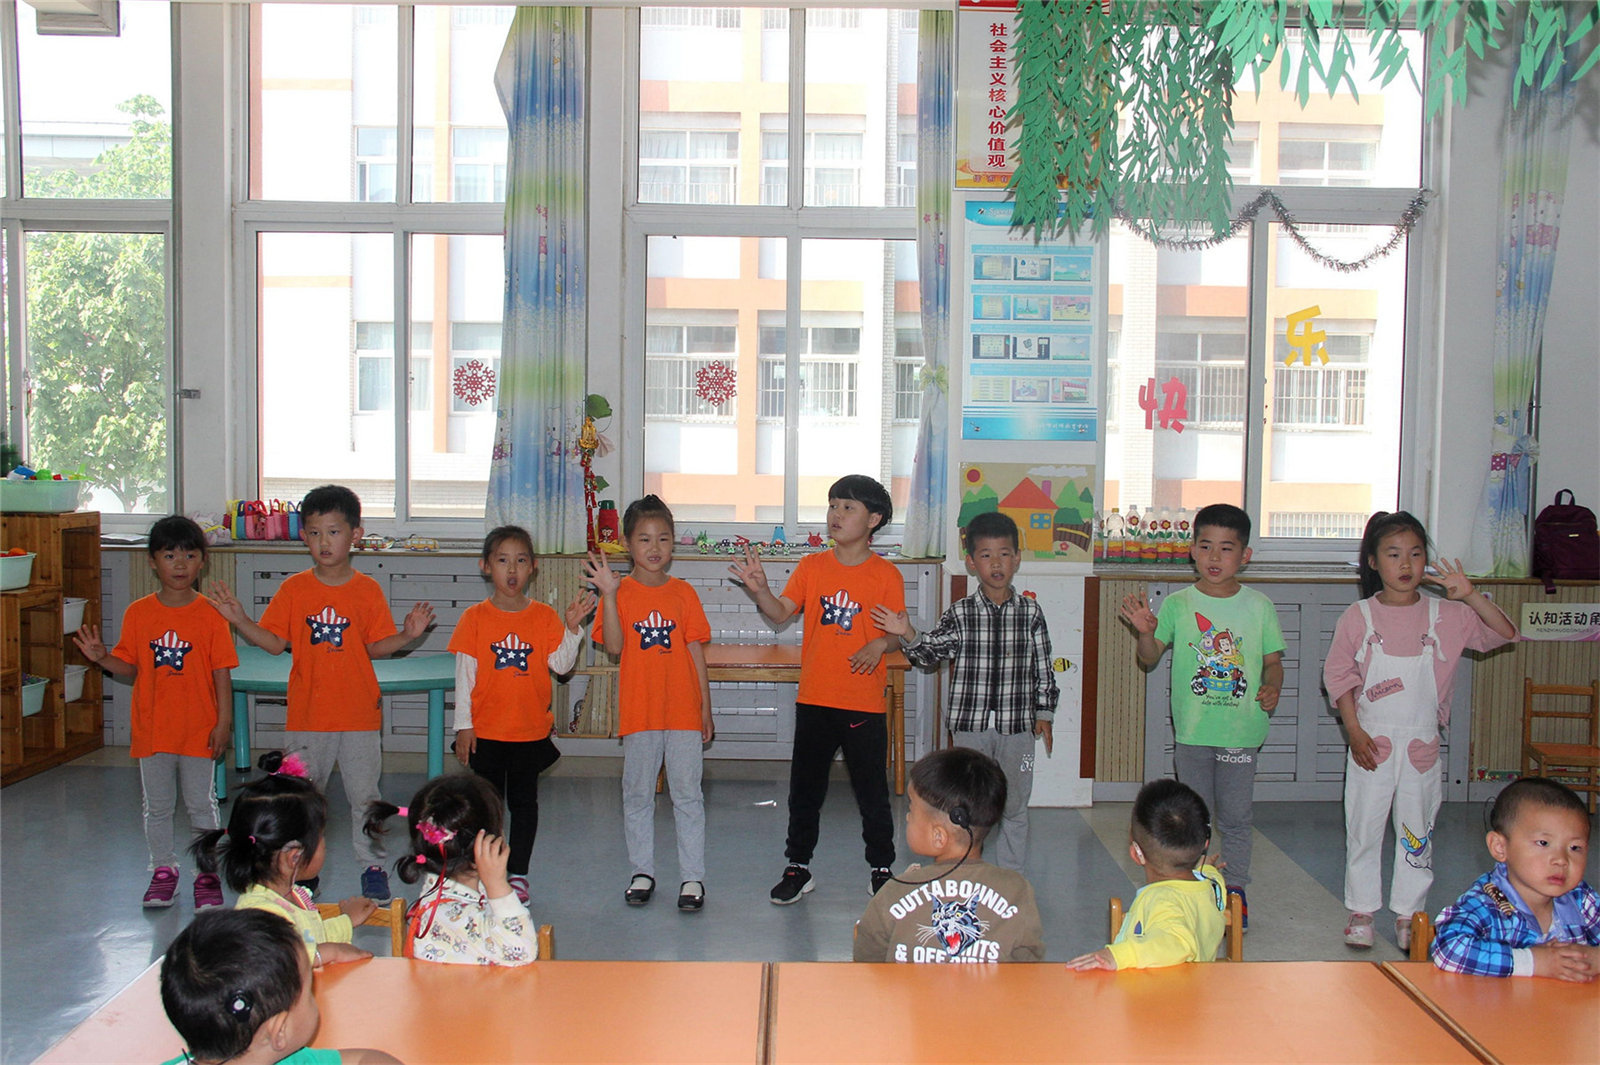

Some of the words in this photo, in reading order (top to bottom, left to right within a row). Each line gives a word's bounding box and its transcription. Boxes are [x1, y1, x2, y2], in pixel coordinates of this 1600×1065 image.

[987, 22, 1008, 168] 社会主义核心价值观
[1283, 304, 1331, 367] 乐
[1138, 376, 1188, 434] 快
[1528, 611, 1600, 626] 认知活动角
[895, 943, 908, 963] &
